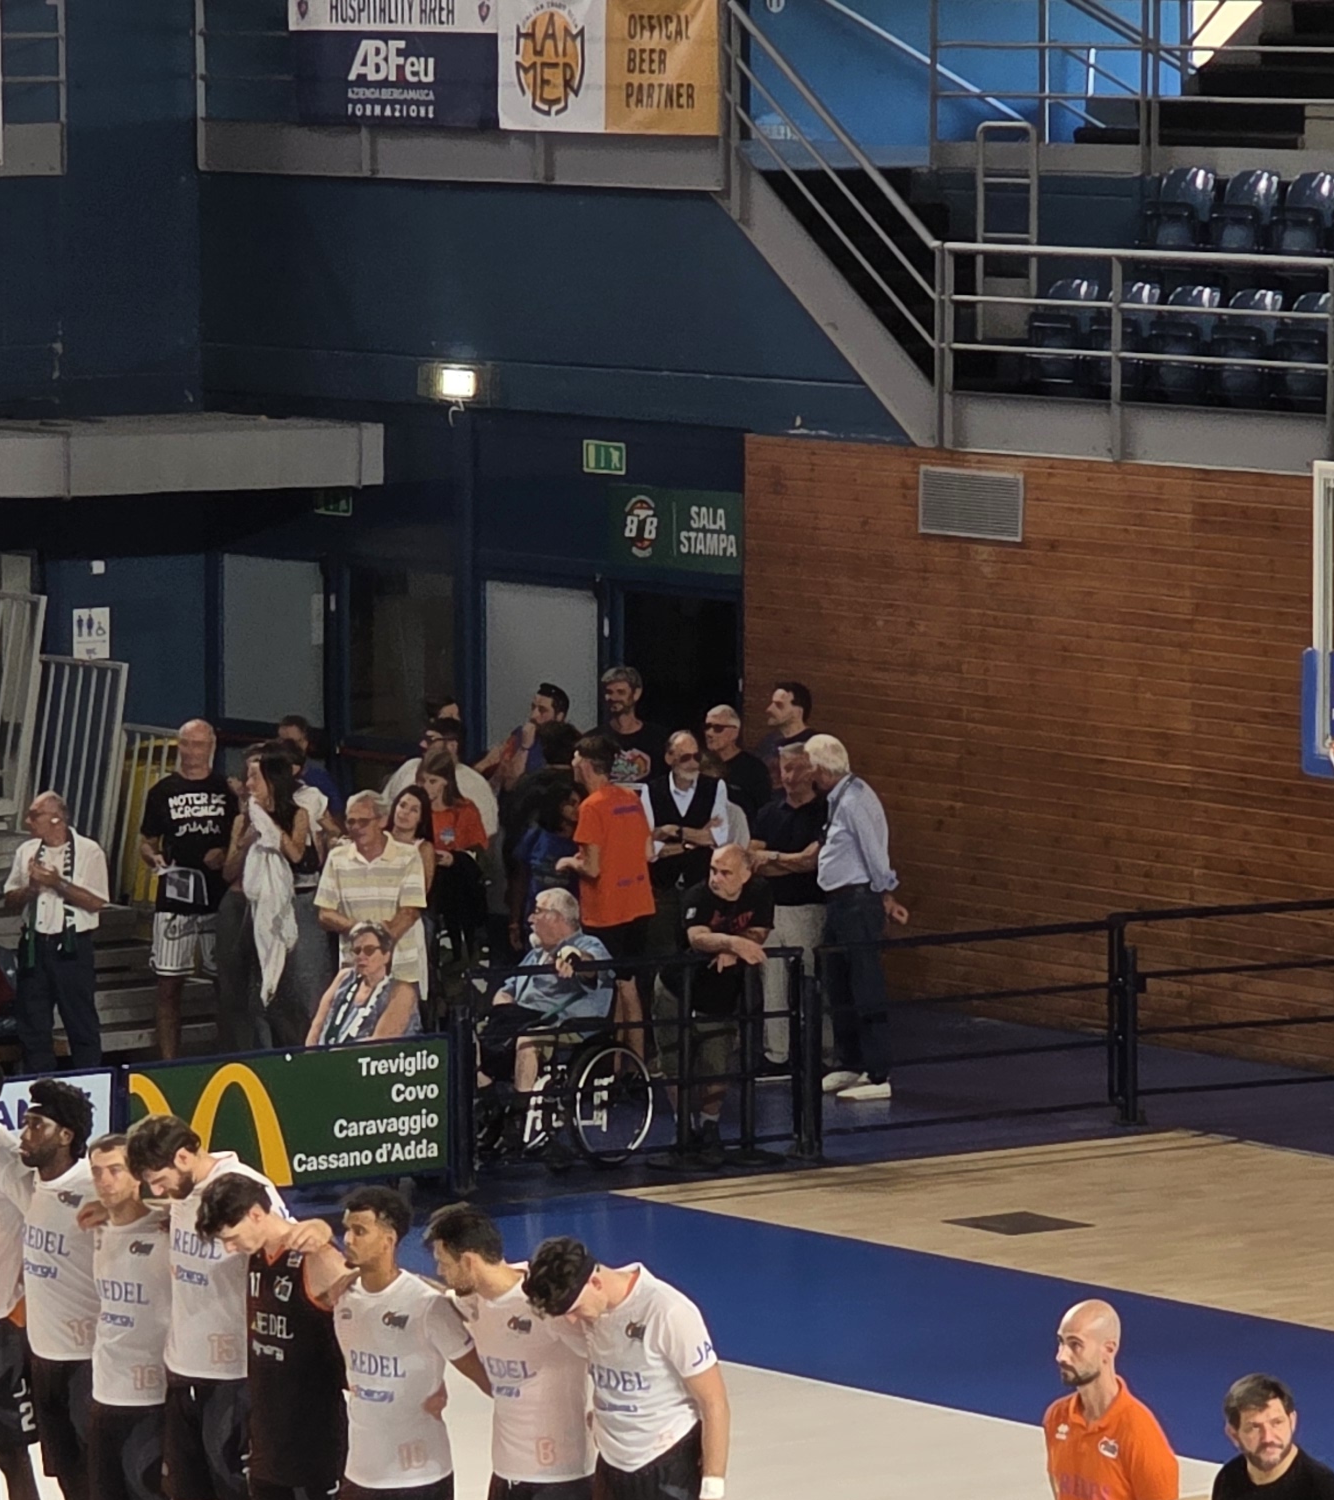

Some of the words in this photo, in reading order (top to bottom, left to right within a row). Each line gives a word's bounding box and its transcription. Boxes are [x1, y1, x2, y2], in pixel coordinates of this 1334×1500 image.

[626, 48, 668, 75] BEER
[625, 82, 696, 110] PARTNER
[689, 504, 727, 532] SALA
[678, 530, 739, 558] STAMPA
[357, 1049, 440, 1077] Treviglio
[390, 1082, 440, 1103] Covo
[333, 1108, 440, 1139] Caravaggio
[292, 1148, 373, 1173] Cassano
[349, 1348, 407, 1379] REDEL
